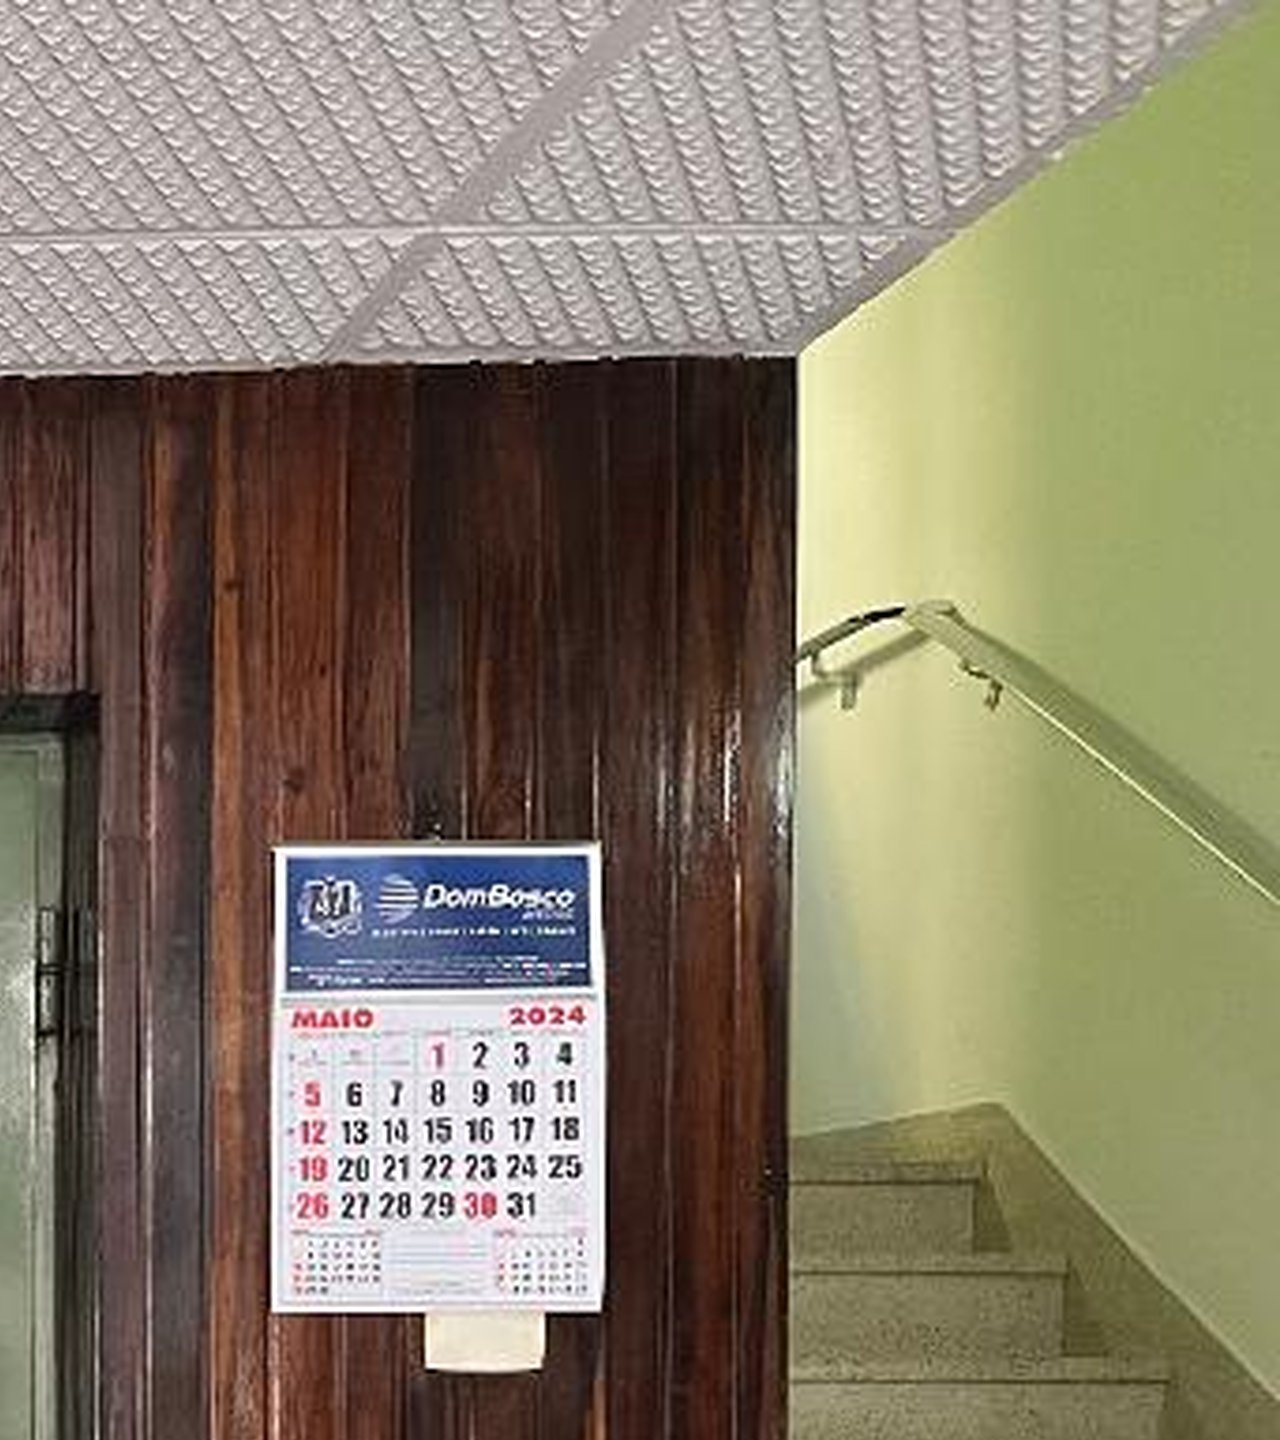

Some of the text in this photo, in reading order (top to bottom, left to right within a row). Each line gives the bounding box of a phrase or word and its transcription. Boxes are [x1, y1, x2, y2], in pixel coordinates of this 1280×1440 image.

[292, 1006, 586, 1029] MAIO 2024
[430, 1041, 573, 1069] 1 2 3 4
[304, 1079, 576, 1108] 5 6 7 8 9 10 11
[302, 1116, 580, 1145] 12 13 14 15 16 17 18
[299, 1154, 583, 1182] 19 20 21 22 23 24 25
[297, 1191, 536, 1220] 26 27 28 29 30 31
